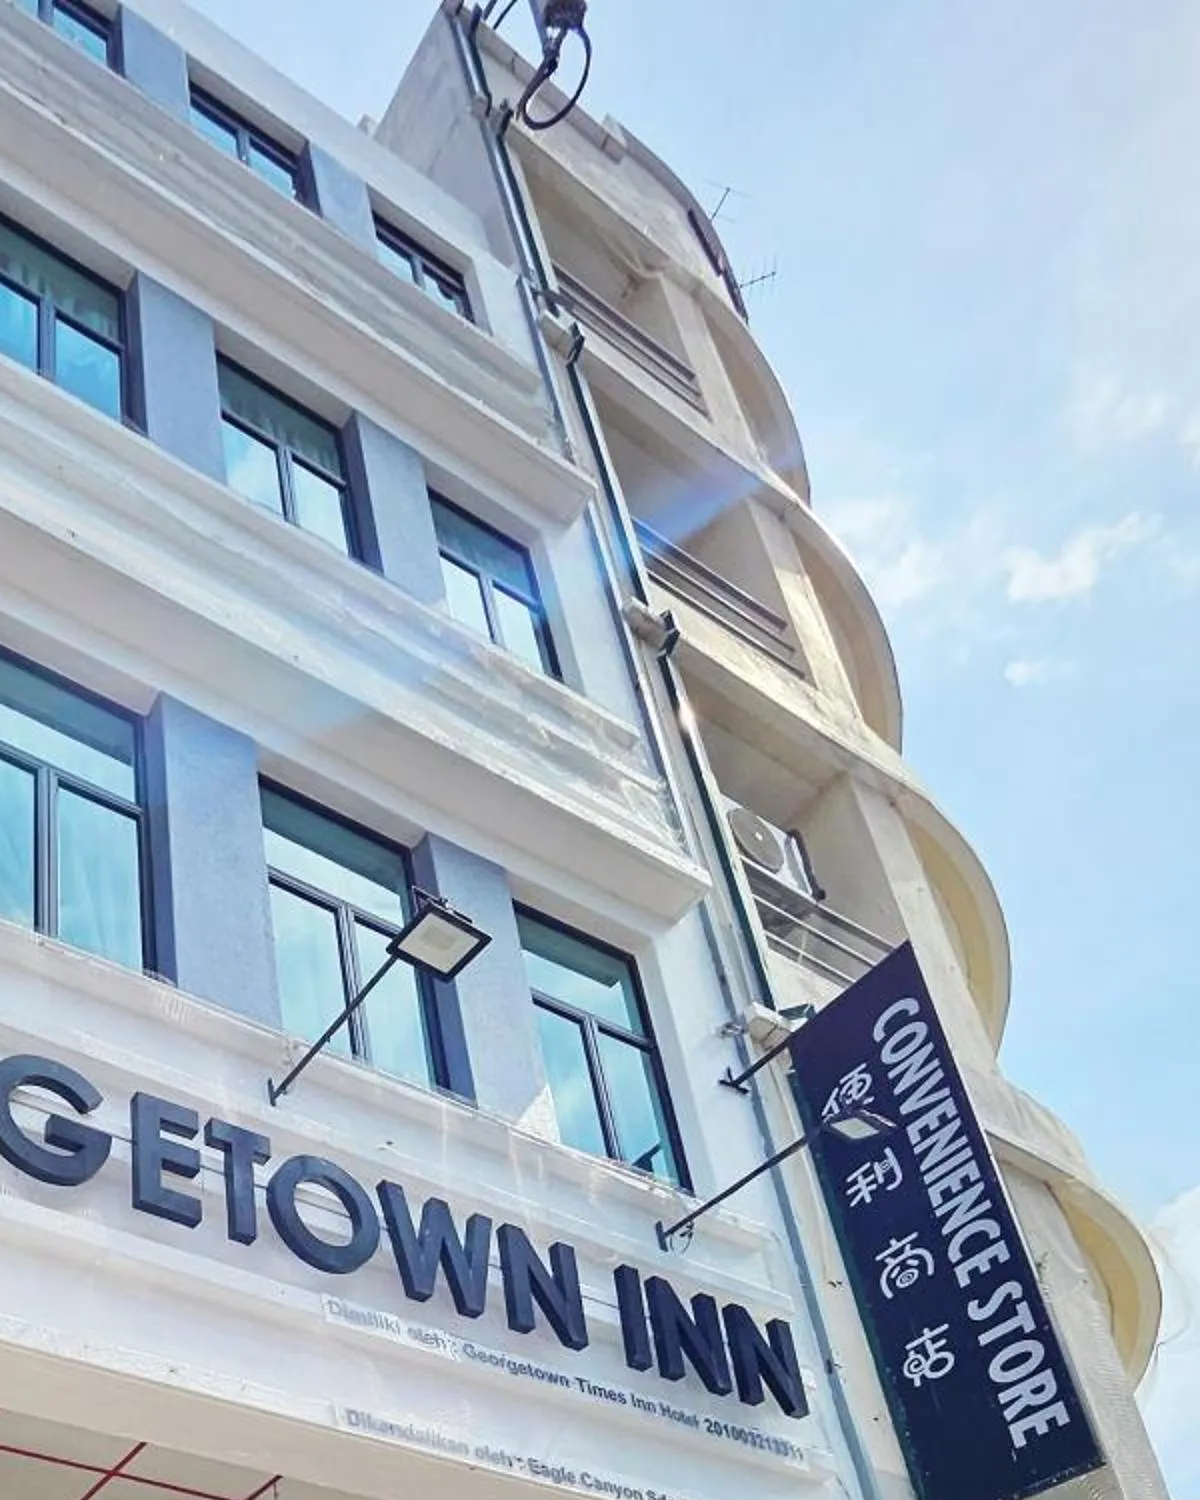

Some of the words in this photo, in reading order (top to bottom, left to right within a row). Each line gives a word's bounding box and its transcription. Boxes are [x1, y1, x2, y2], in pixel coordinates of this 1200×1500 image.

[872, 996, 1010, 1289] CONVENIENCE
[967, 1280, 1071, 1450] STORE
[462, 1342, 570, 1388] Georgetown
[574, 1376, 627, 1406] Times
[630, 1391, 657, 1413] Inn
[614, 1263, 810, 1418] INN
[527, 1455, 577, 1487] Eagle
